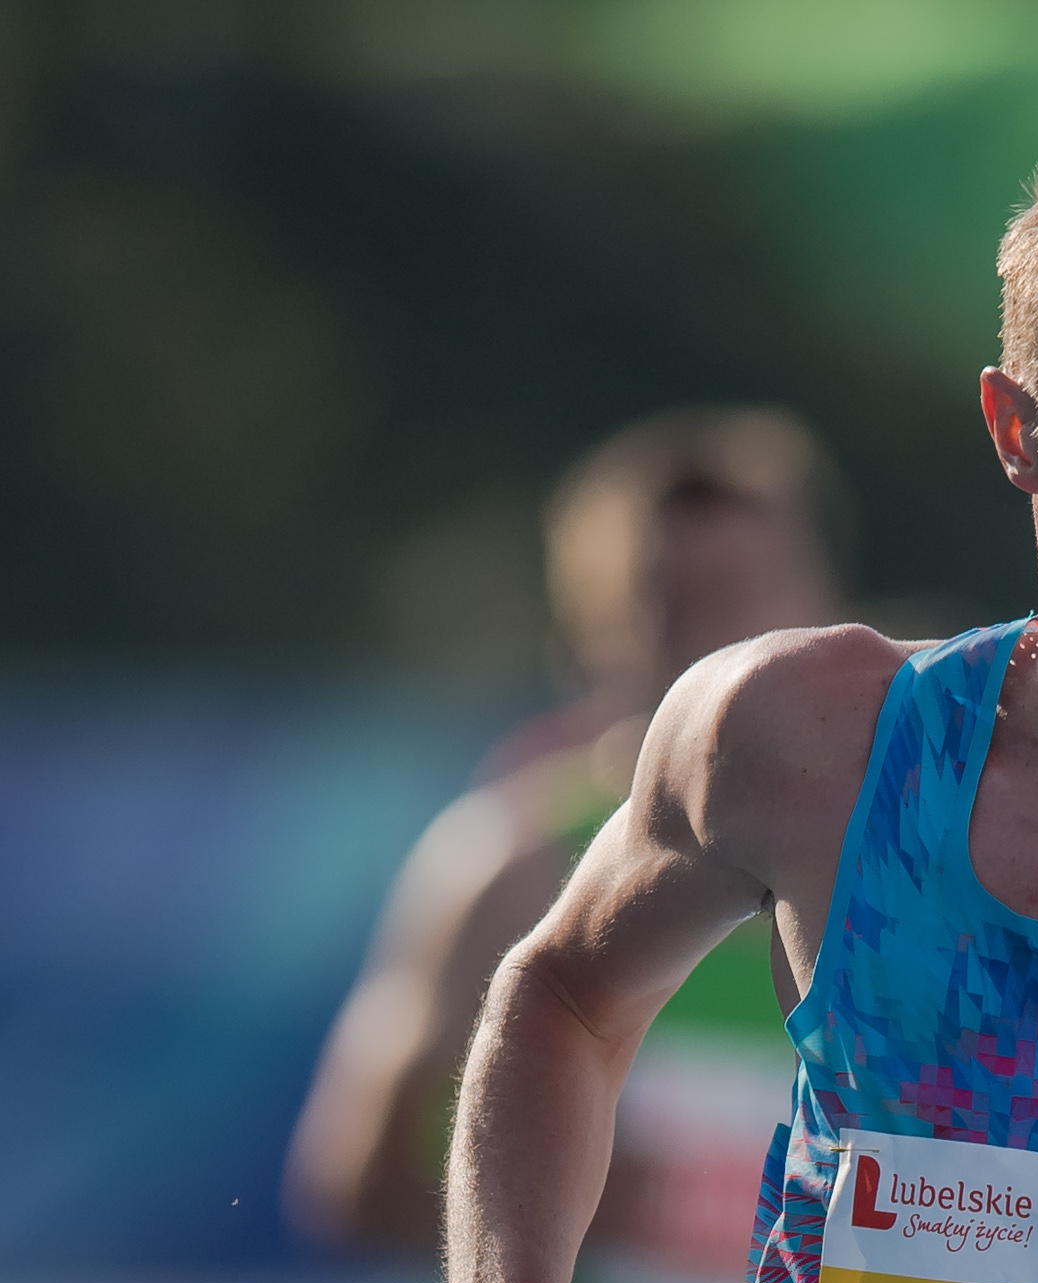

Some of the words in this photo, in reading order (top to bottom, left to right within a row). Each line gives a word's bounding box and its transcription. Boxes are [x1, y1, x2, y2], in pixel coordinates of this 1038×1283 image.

[890, 1173, 1032, 1218] lubelskie
[903, 1213, 974, 1252] Smakuj
[975, 1220, 1034, 1251] życie!
